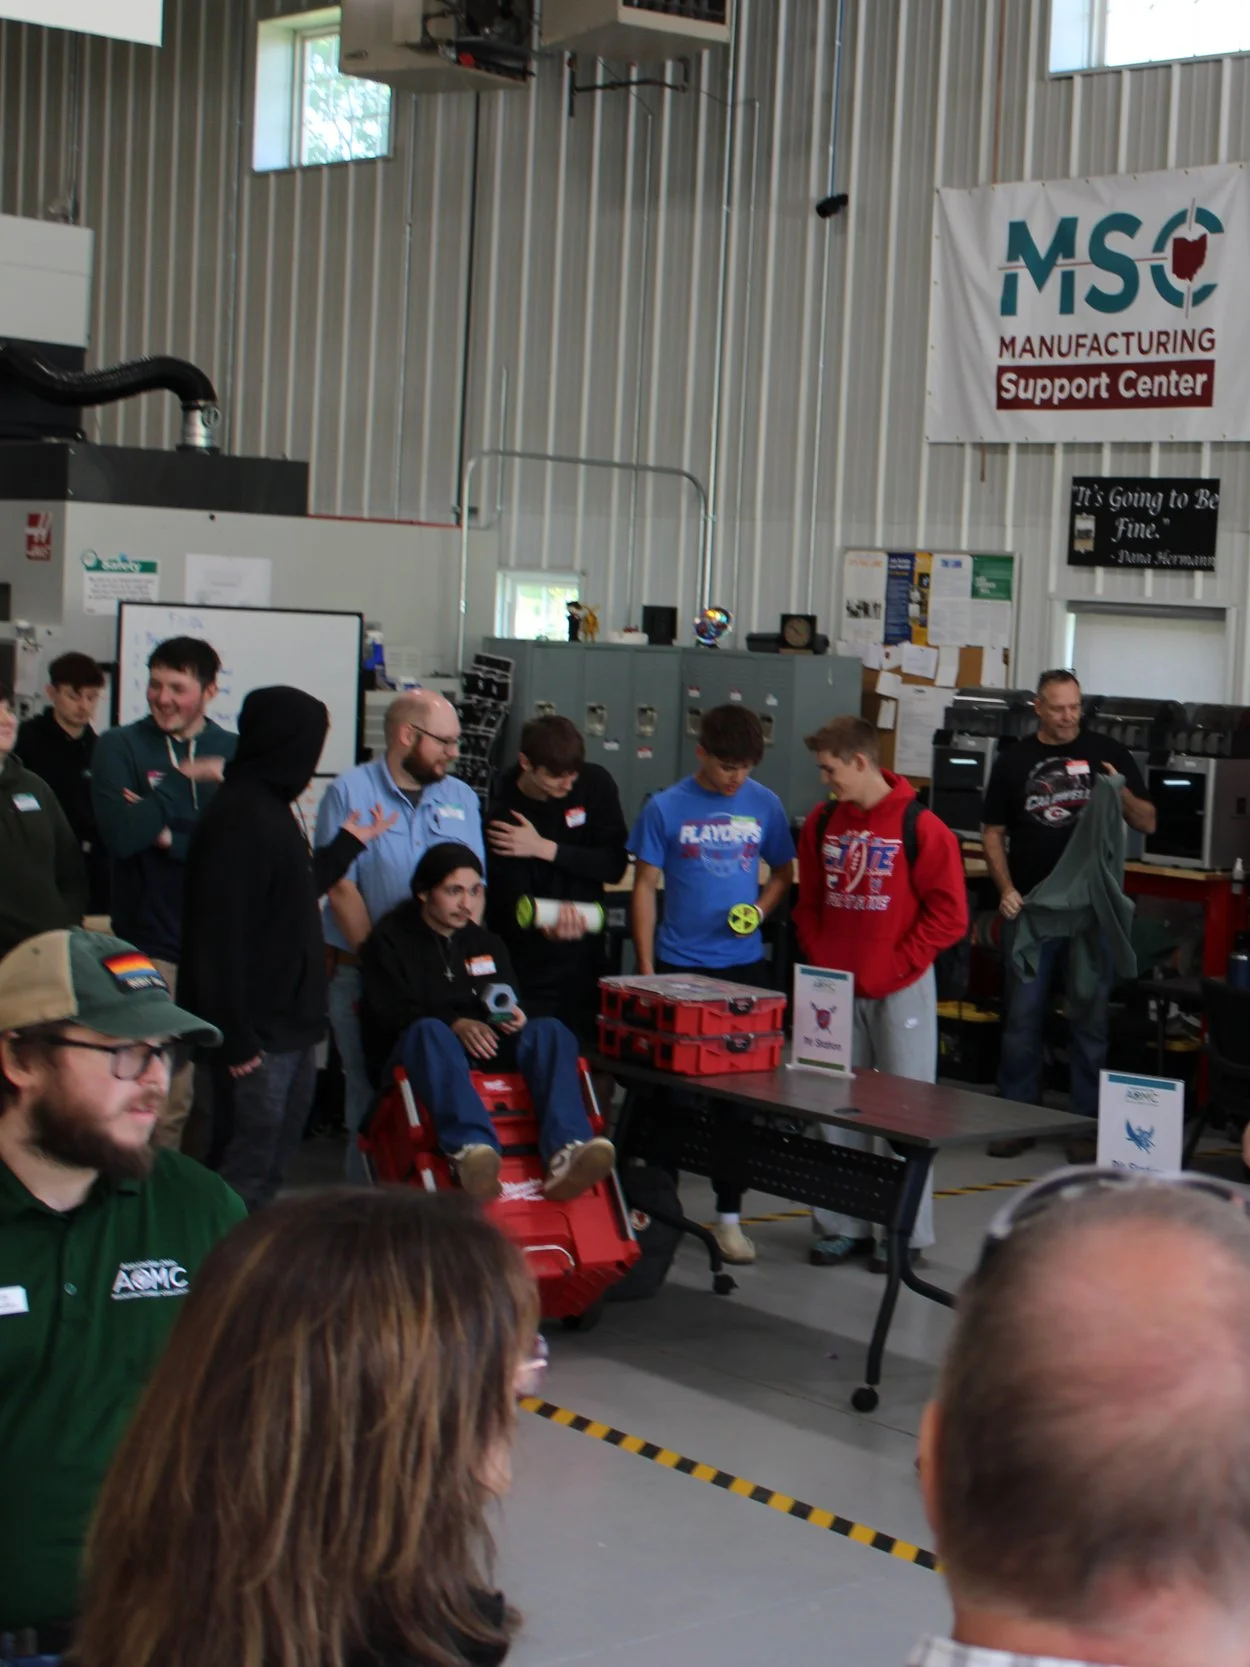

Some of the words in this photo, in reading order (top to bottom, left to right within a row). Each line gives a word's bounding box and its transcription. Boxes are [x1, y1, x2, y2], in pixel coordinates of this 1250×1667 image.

[1000, 206, 1225, 317] MSC
[999, 327, 1216, 360] MANUFACTURING
[1000, 372, 1110, 405] Support
[1118, 369, 1208, 400] Center
[1109, 486, 1164, 516] Going
[1169, 488, 1189, 509] to
[1194, 488, 1220, 510] Be
